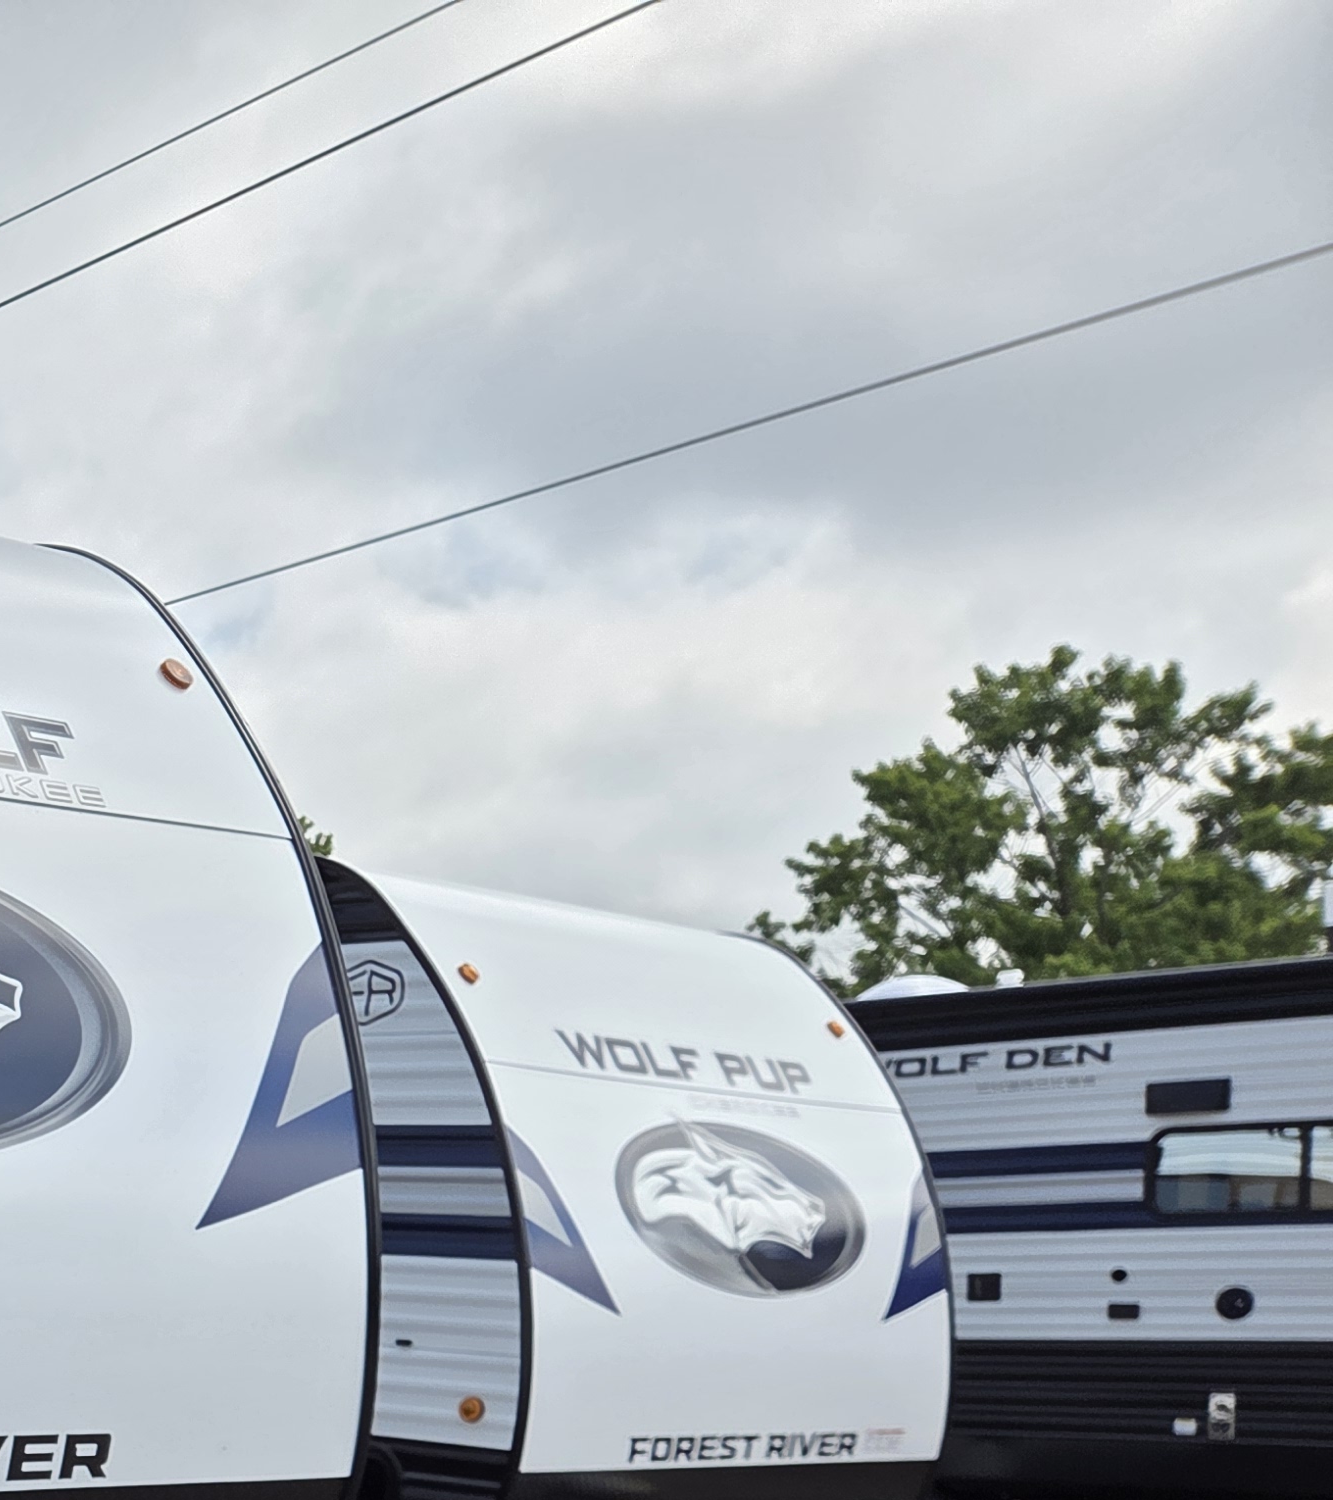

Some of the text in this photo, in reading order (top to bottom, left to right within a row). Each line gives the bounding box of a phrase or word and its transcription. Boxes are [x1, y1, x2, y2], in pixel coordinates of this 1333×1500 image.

[554, 1028, 812, 1095] WOLF PUP
[1006, 1042, 1112, 1071] DEN
[628, 1434, 759, 1463] FOREST
[765, 1433, 858, 1458] RIVER
